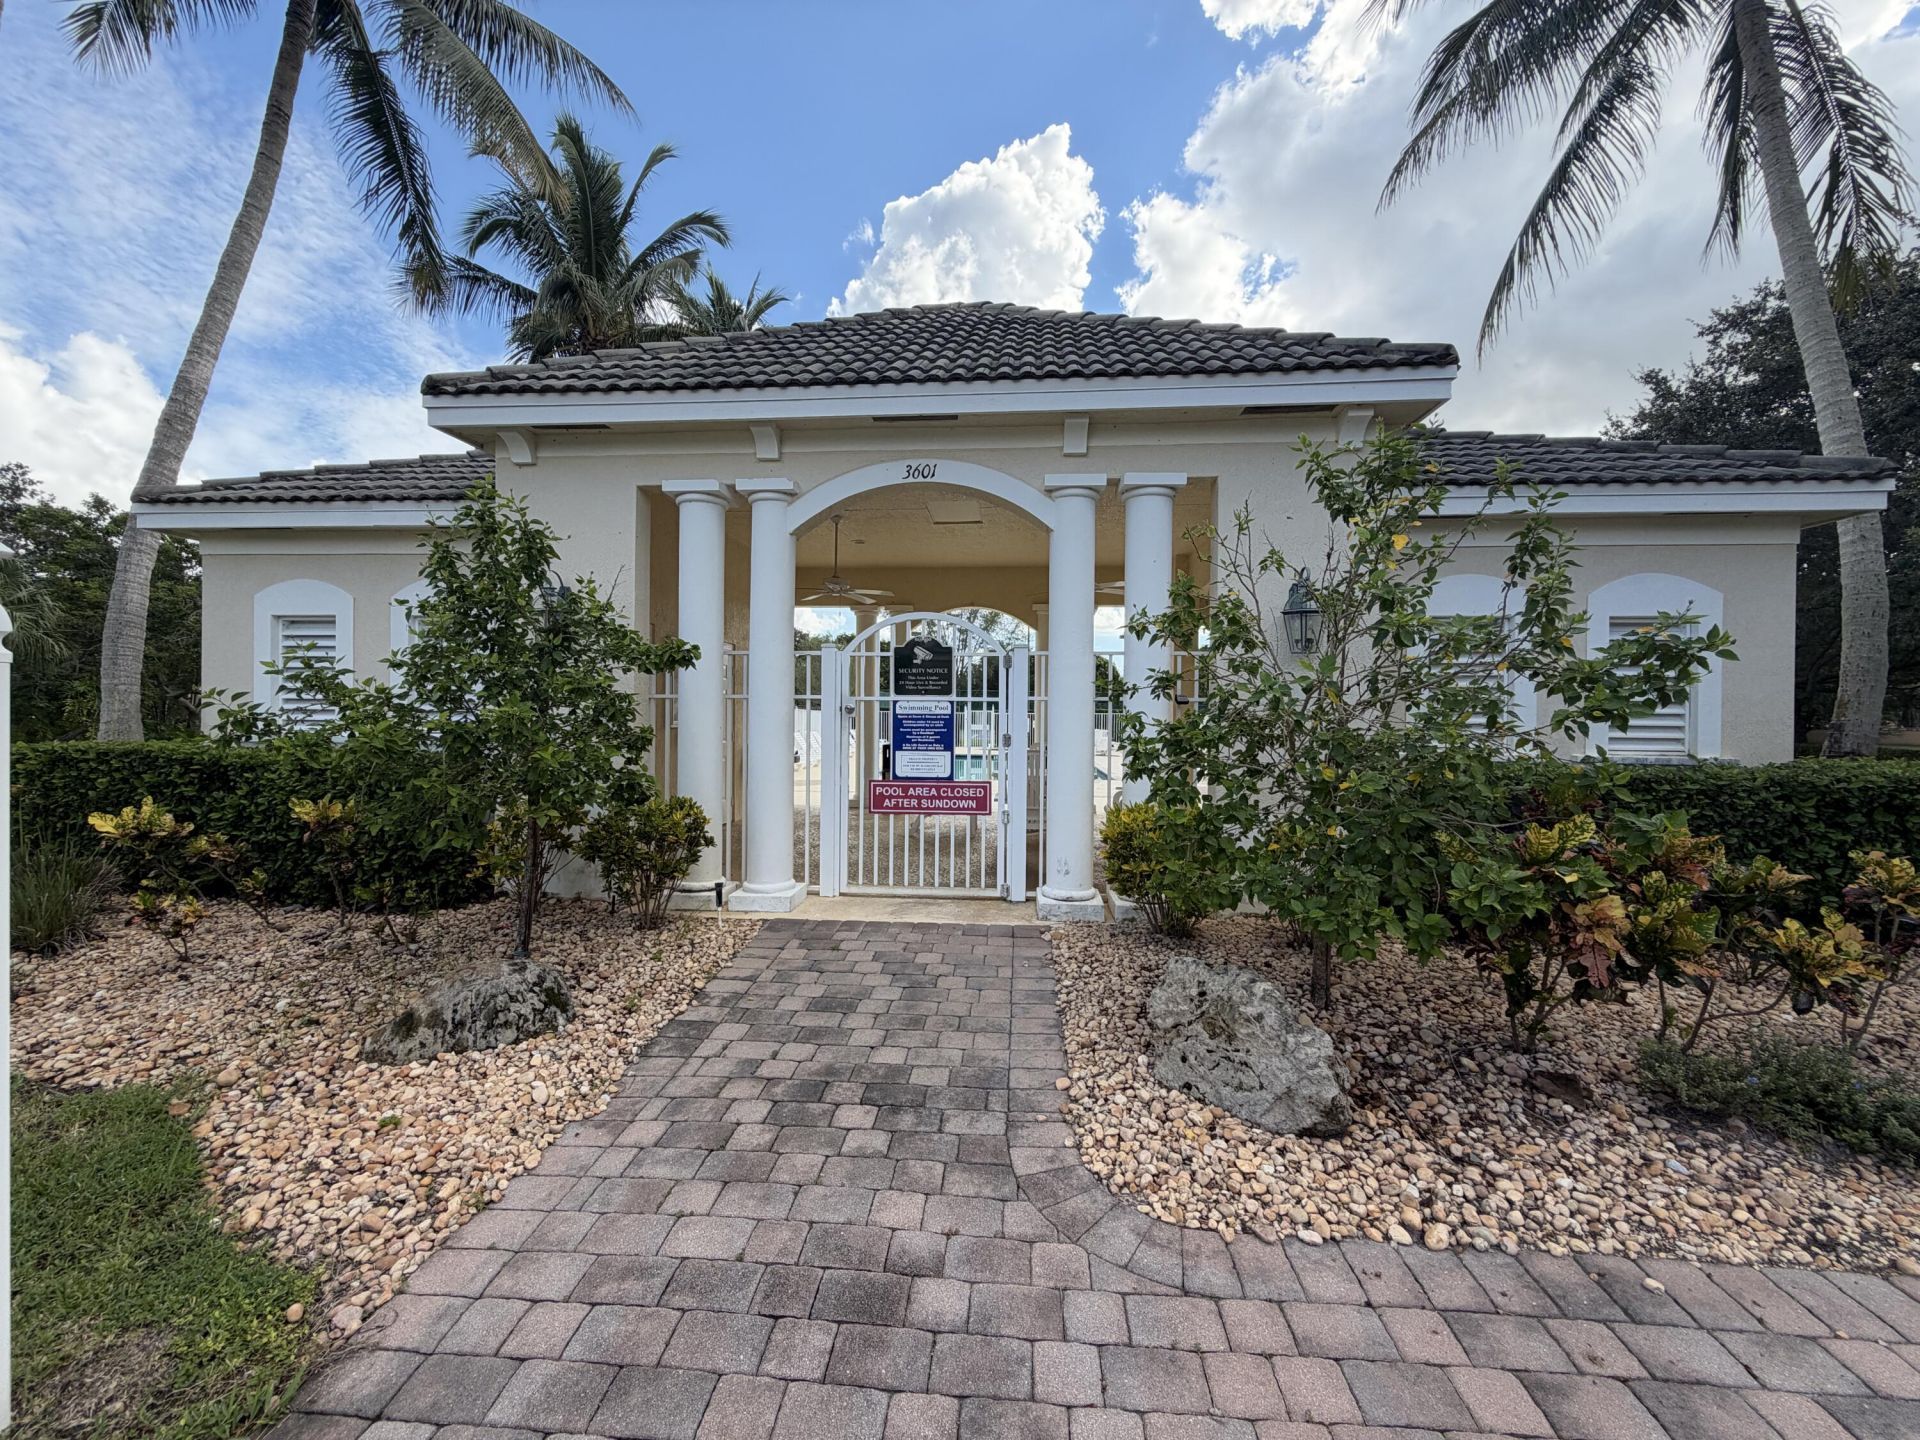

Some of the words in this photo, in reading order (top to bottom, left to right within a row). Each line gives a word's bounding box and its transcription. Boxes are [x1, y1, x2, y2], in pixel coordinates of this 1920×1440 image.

[901, 463, 938, 480] 3601
[875, 786, 905, 796] POOL
[907, 787, 938, 797] AREA
[940, 787, 984, 797] CLOSED
[883, 798, 919, 808] AFTER
[921, 799, 976, 809] SUNDOWN
